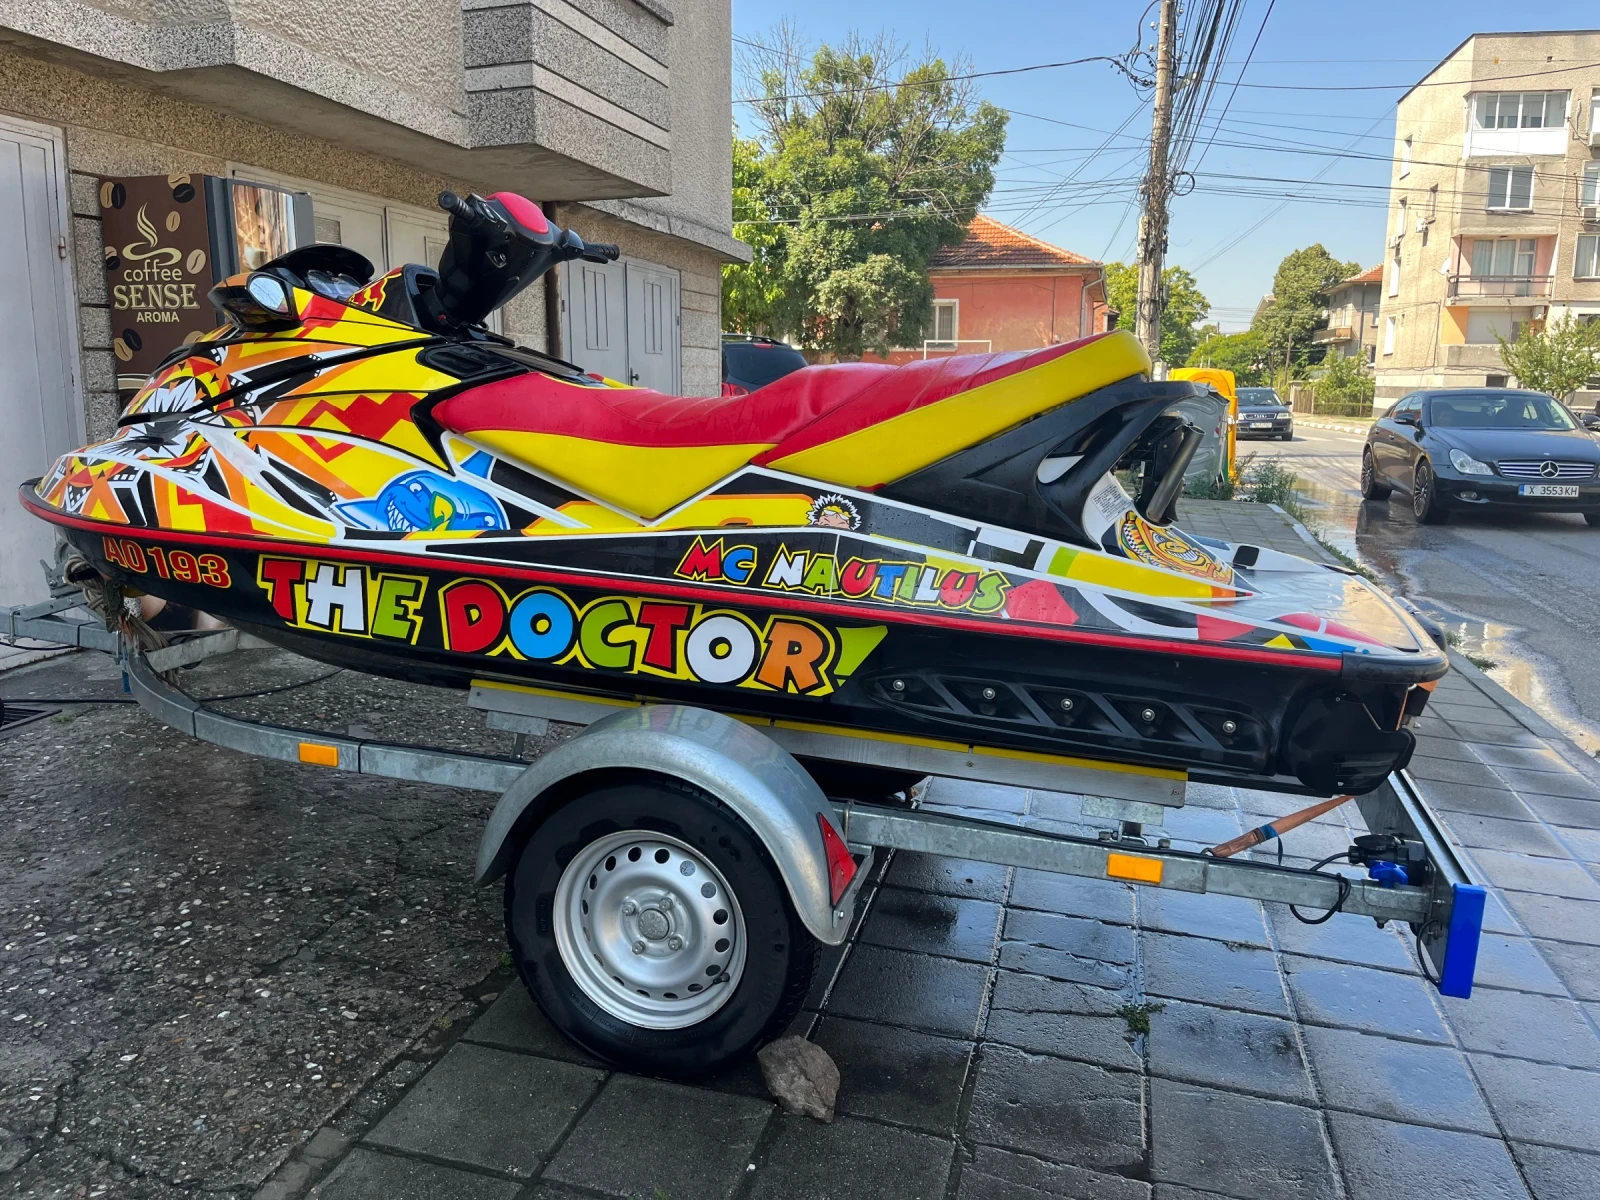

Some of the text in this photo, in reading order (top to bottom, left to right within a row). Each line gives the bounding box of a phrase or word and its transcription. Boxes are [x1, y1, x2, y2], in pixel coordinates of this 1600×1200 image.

[123, 259, 182, 281] coffee
[114, 283, 199, 310] SENSE
[137, 312, 180, 323] AROMA
[1529, 486, 1536, 495] X
[673, 535, 1010, 613] MC NAUTILUS
[256, 554, 429, 646] THE
